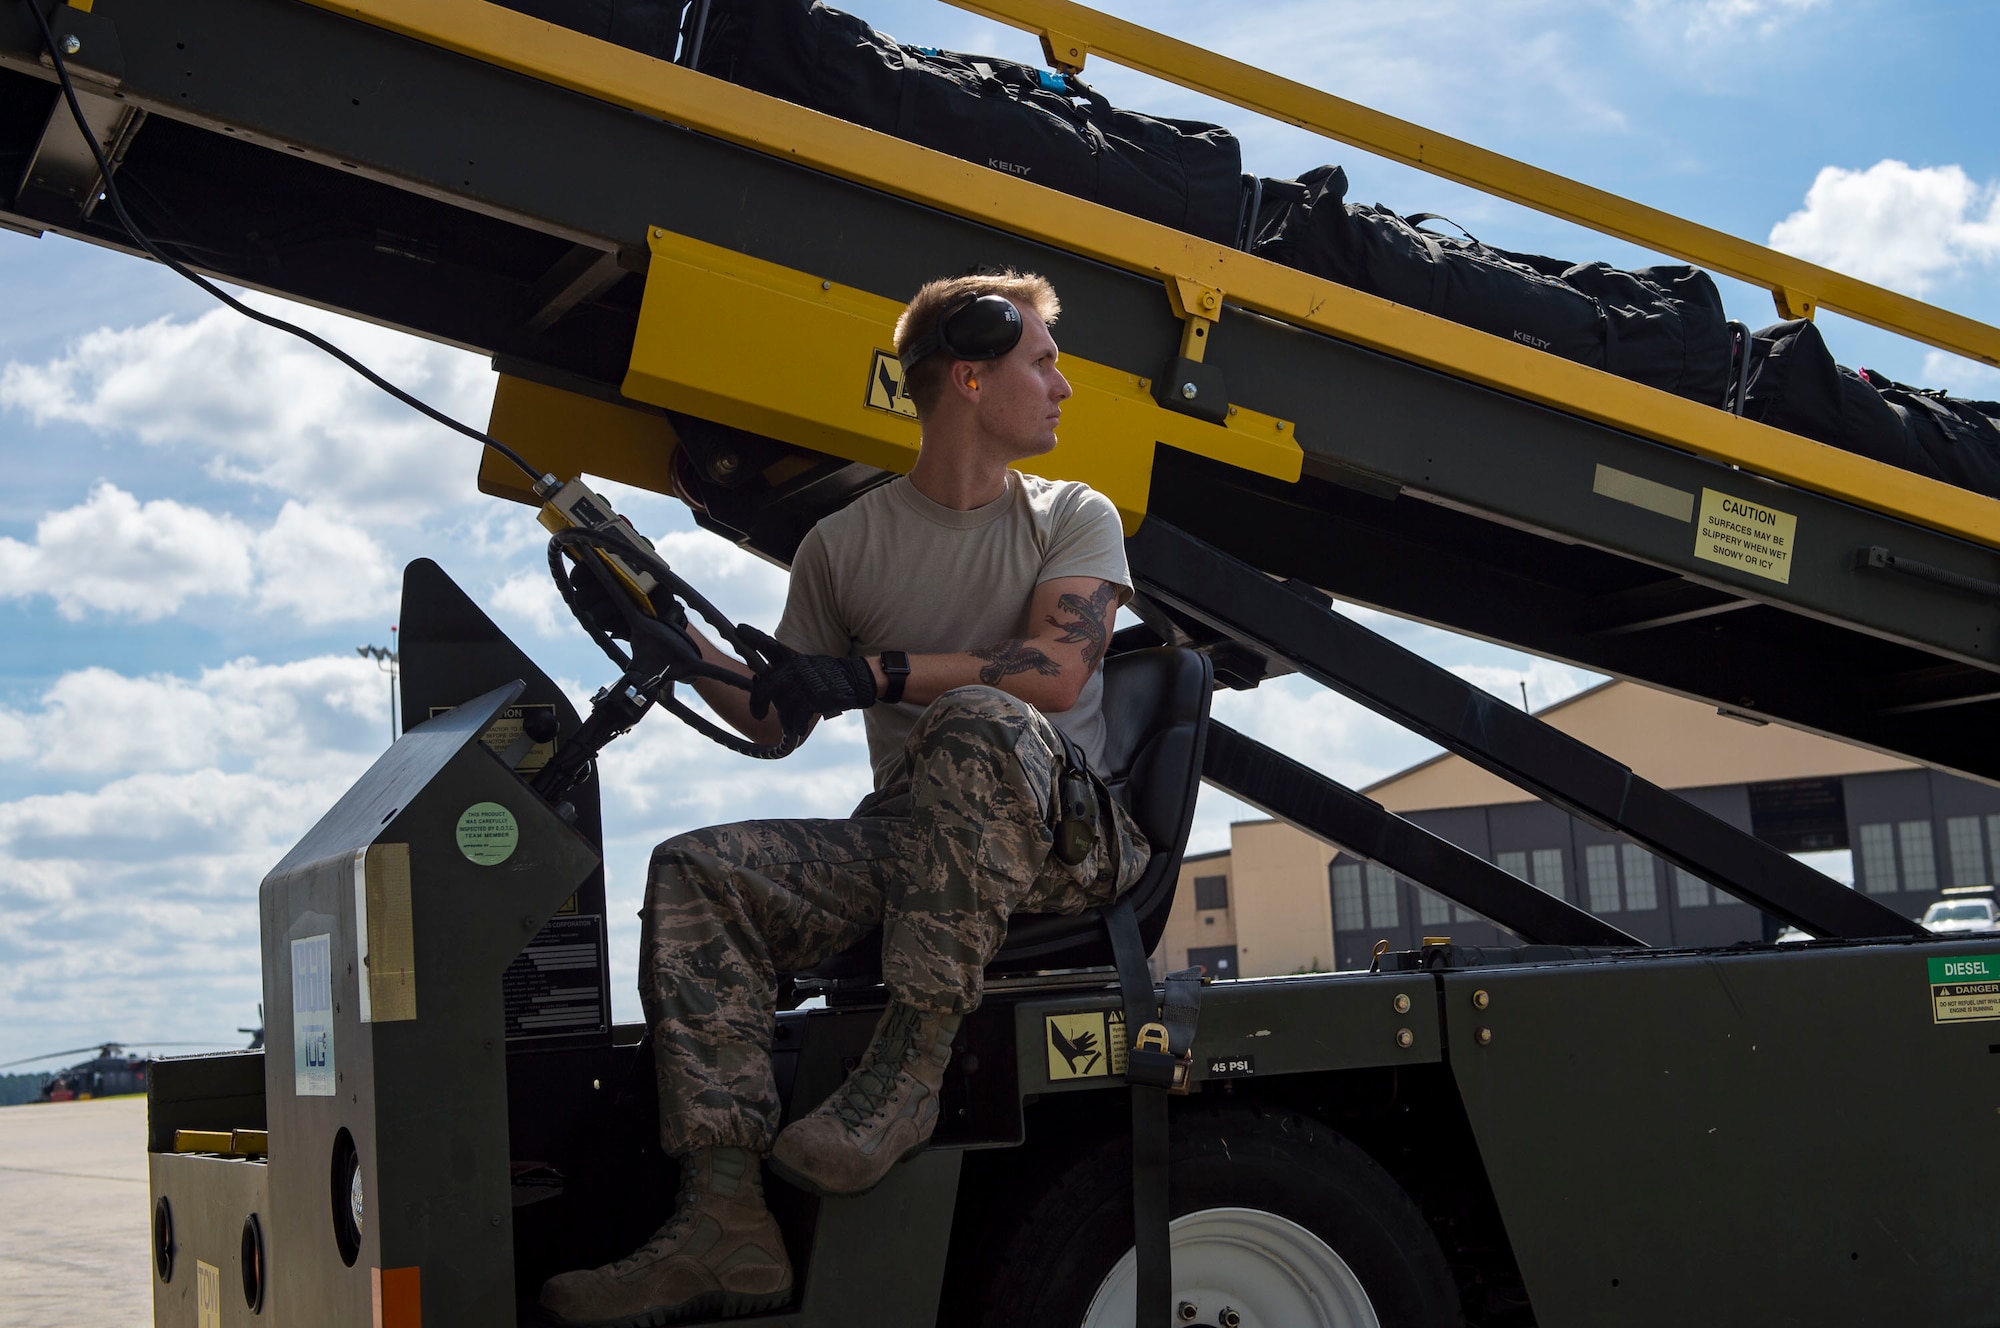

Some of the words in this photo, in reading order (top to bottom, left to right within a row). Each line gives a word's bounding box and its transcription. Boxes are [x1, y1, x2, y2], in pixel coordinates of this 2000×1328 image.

[988, 158, 1031, 176] KELTY
[1513, 330, 1551, 350] KELTY
[1722, 499, 1776, 526] CAUTION
[1708, 515, 1752, 536] SURFACES
[1754, 529, 1772, 542] MAY
[1773, 535, 1784, 546] BE
[1702, 528, 1742, 547] SLIPPERY
[1743, 540, 1768, 554] WHEN
[1769, 547, 1788, 561] WET
[1713, 544, 1744, 560] SNOWY
[1745, 554, 1758, 565] OR
[1758, 558, 1774, 570] ICY
[1945, 962, 1989, 976] DIESEL
[1956, 985, 1999, 994] DANGER
[302, 1025, 326, 1068] TUG
[1212, 1062, 1226, 1072] 45
[1229, 1061, 1248, 1071] PSI
[199, 1267, 218, 1313] TOW
